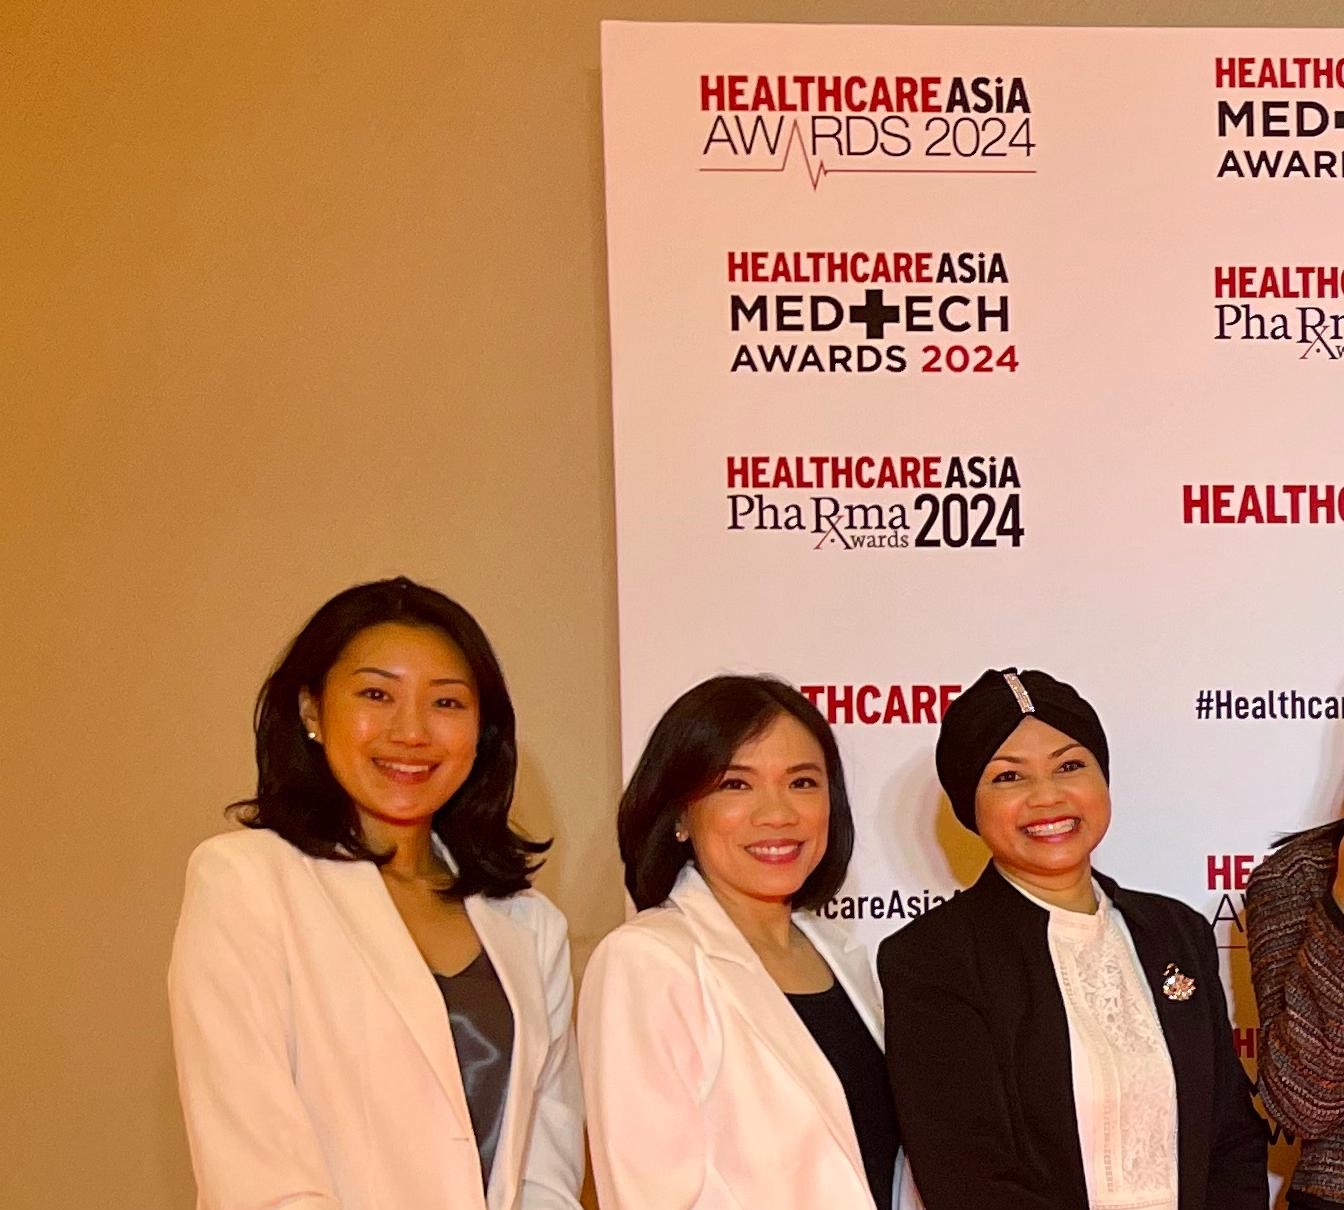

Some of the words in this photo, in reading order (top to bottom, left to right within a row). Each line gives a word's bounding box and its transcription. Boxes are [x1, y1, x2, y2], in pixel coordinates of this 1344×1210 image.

[924, 116, 1037, 158] 2024
[731, 345, 906, 372] AWARDS
[922, 345, 1019, 373] 2024
[914, 493, 1024, 547] 2024
